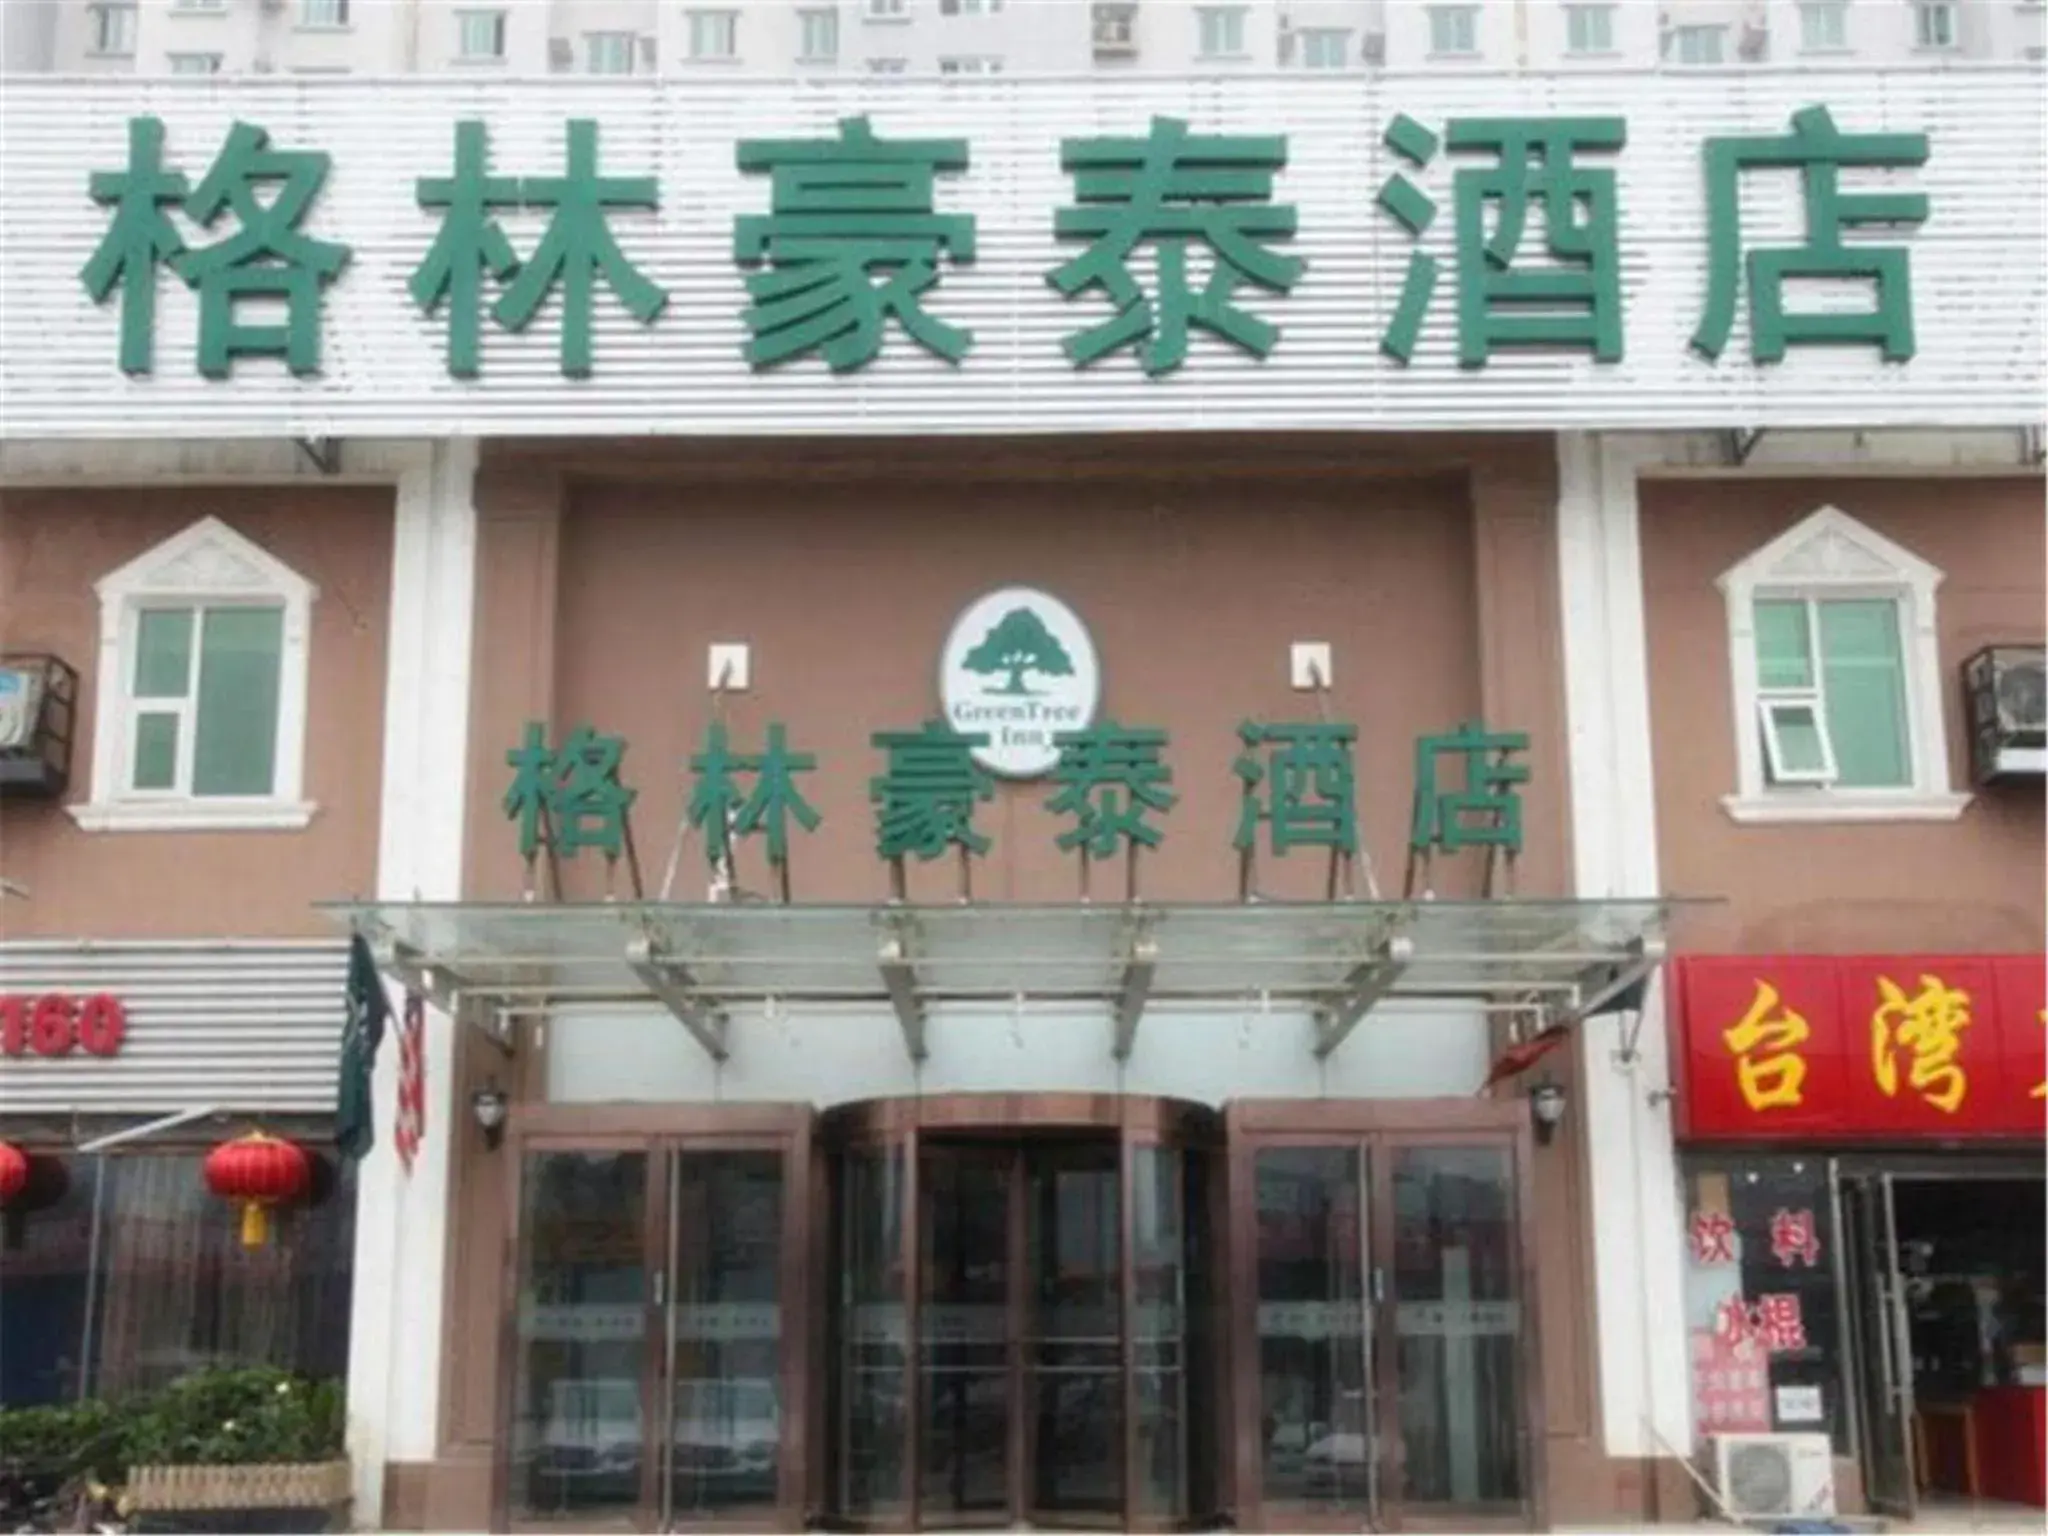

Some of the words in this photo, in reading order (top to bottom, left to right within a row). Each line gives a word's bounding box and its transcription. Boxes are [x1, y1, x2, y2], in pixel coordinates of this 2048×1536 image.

[81, 105, 1929, 377] 格林豪泰酒店
[953, 701, 1081, 721] GreenTree
[504, 720, 1531, 860] 格林豪泰酒店
[1722, 975, 2046, 1112] 台湾
